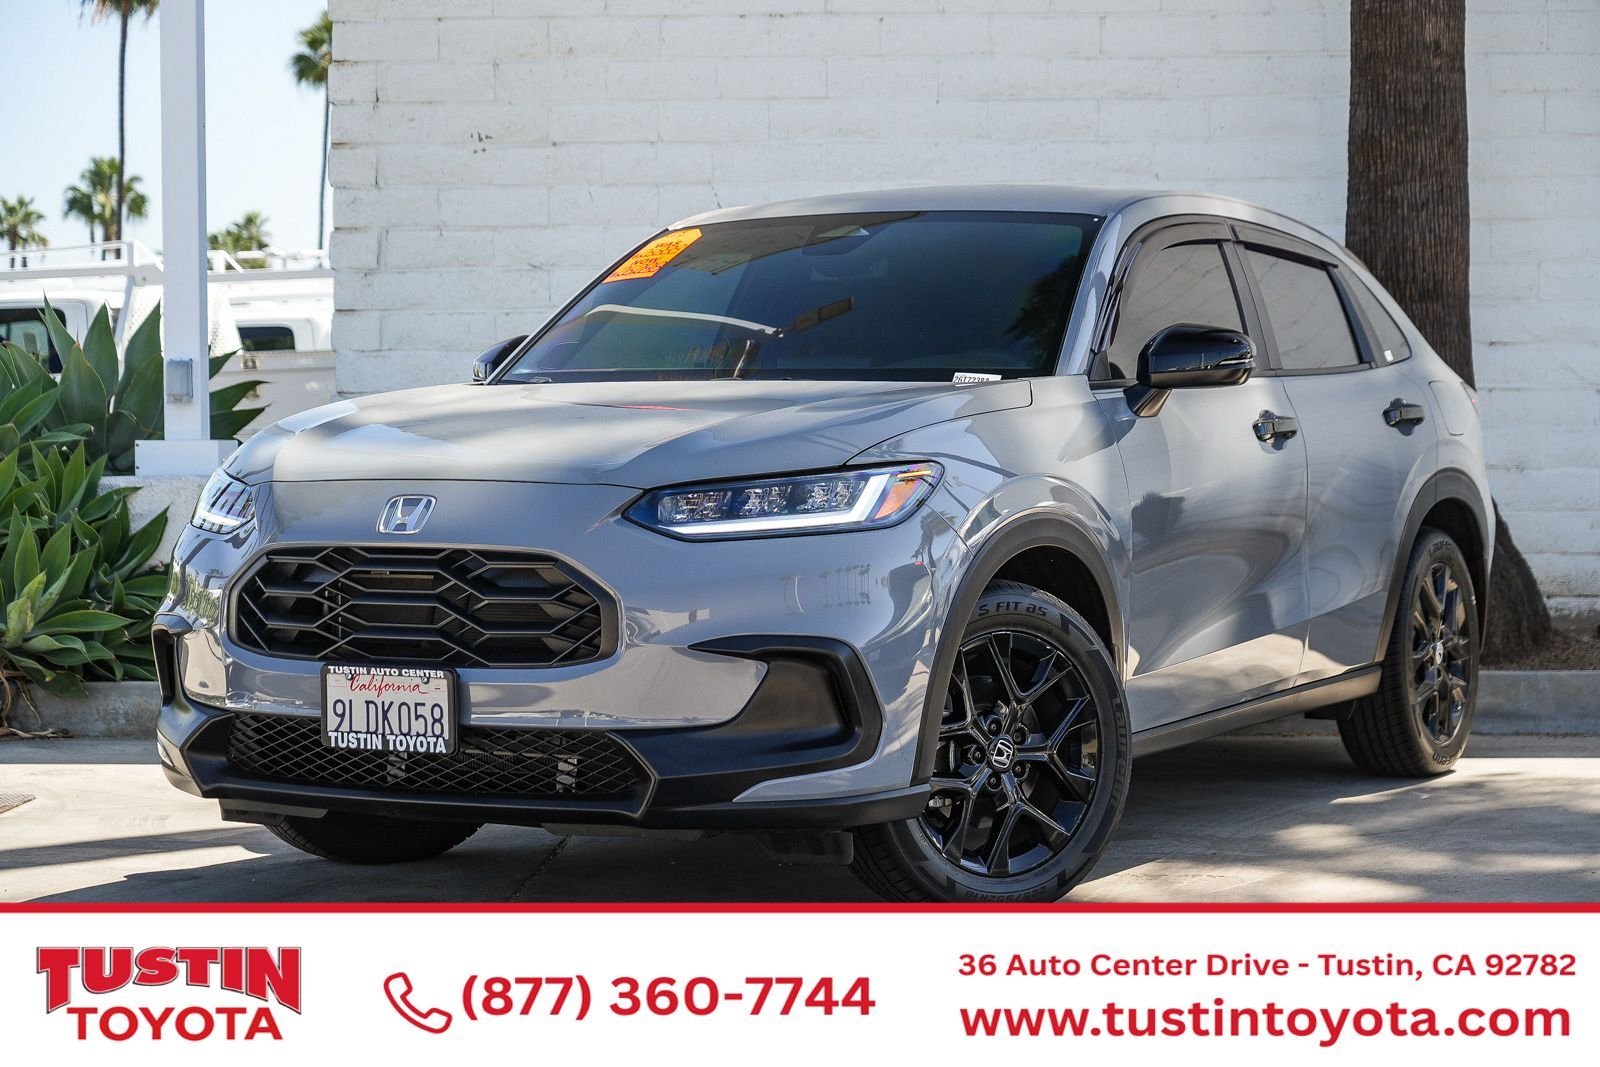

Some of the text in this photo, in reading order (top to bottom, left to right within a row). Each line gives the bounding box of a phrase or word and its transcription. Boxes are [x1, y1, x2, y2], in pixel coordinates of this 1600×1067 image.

[995, 601, 1022, 612] FIT
[328, 665, 444, 678] TUSTIN AUTO CENTER
[350, 674, 429, 697] California
[331, 698, 445, 738] 9LDK058
[328, 731, 447, 753] TUSTIN TOYOTA
